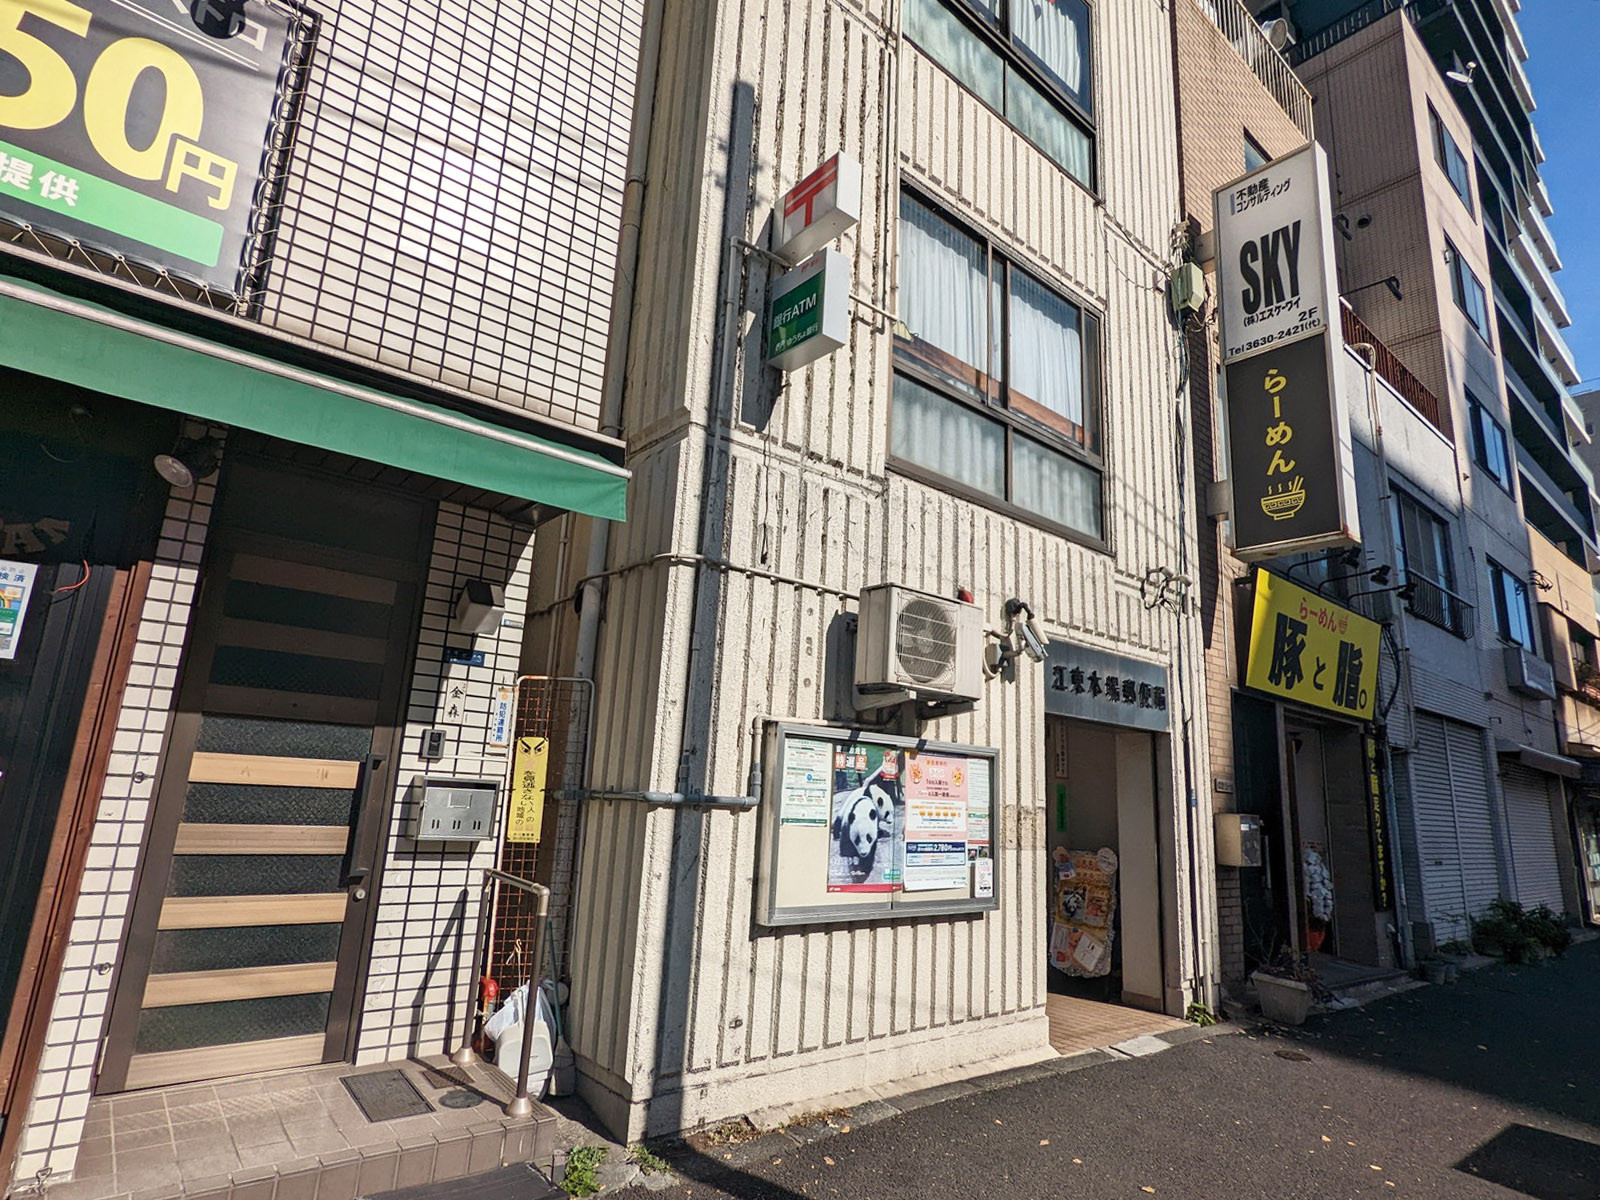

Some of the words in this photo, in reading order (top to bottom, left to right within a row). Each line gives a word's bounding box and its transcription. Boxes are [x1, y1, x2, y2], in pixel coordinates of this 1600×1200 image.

[1236, 178, 1269, 200] 不動産
[1236, 178, 1291, 213] コンサルティング
[1239, 219, 1301, 315] SKY
[772, 293, 817, 330] 銀行ATM
[1298, 306, 1318, 323] 2F
[1263, 368, 1296, 476] らーめん
[1298, 596, 1337, 633] らーめん
[1051, 665, 1167, 712] 江東木場郵便局
